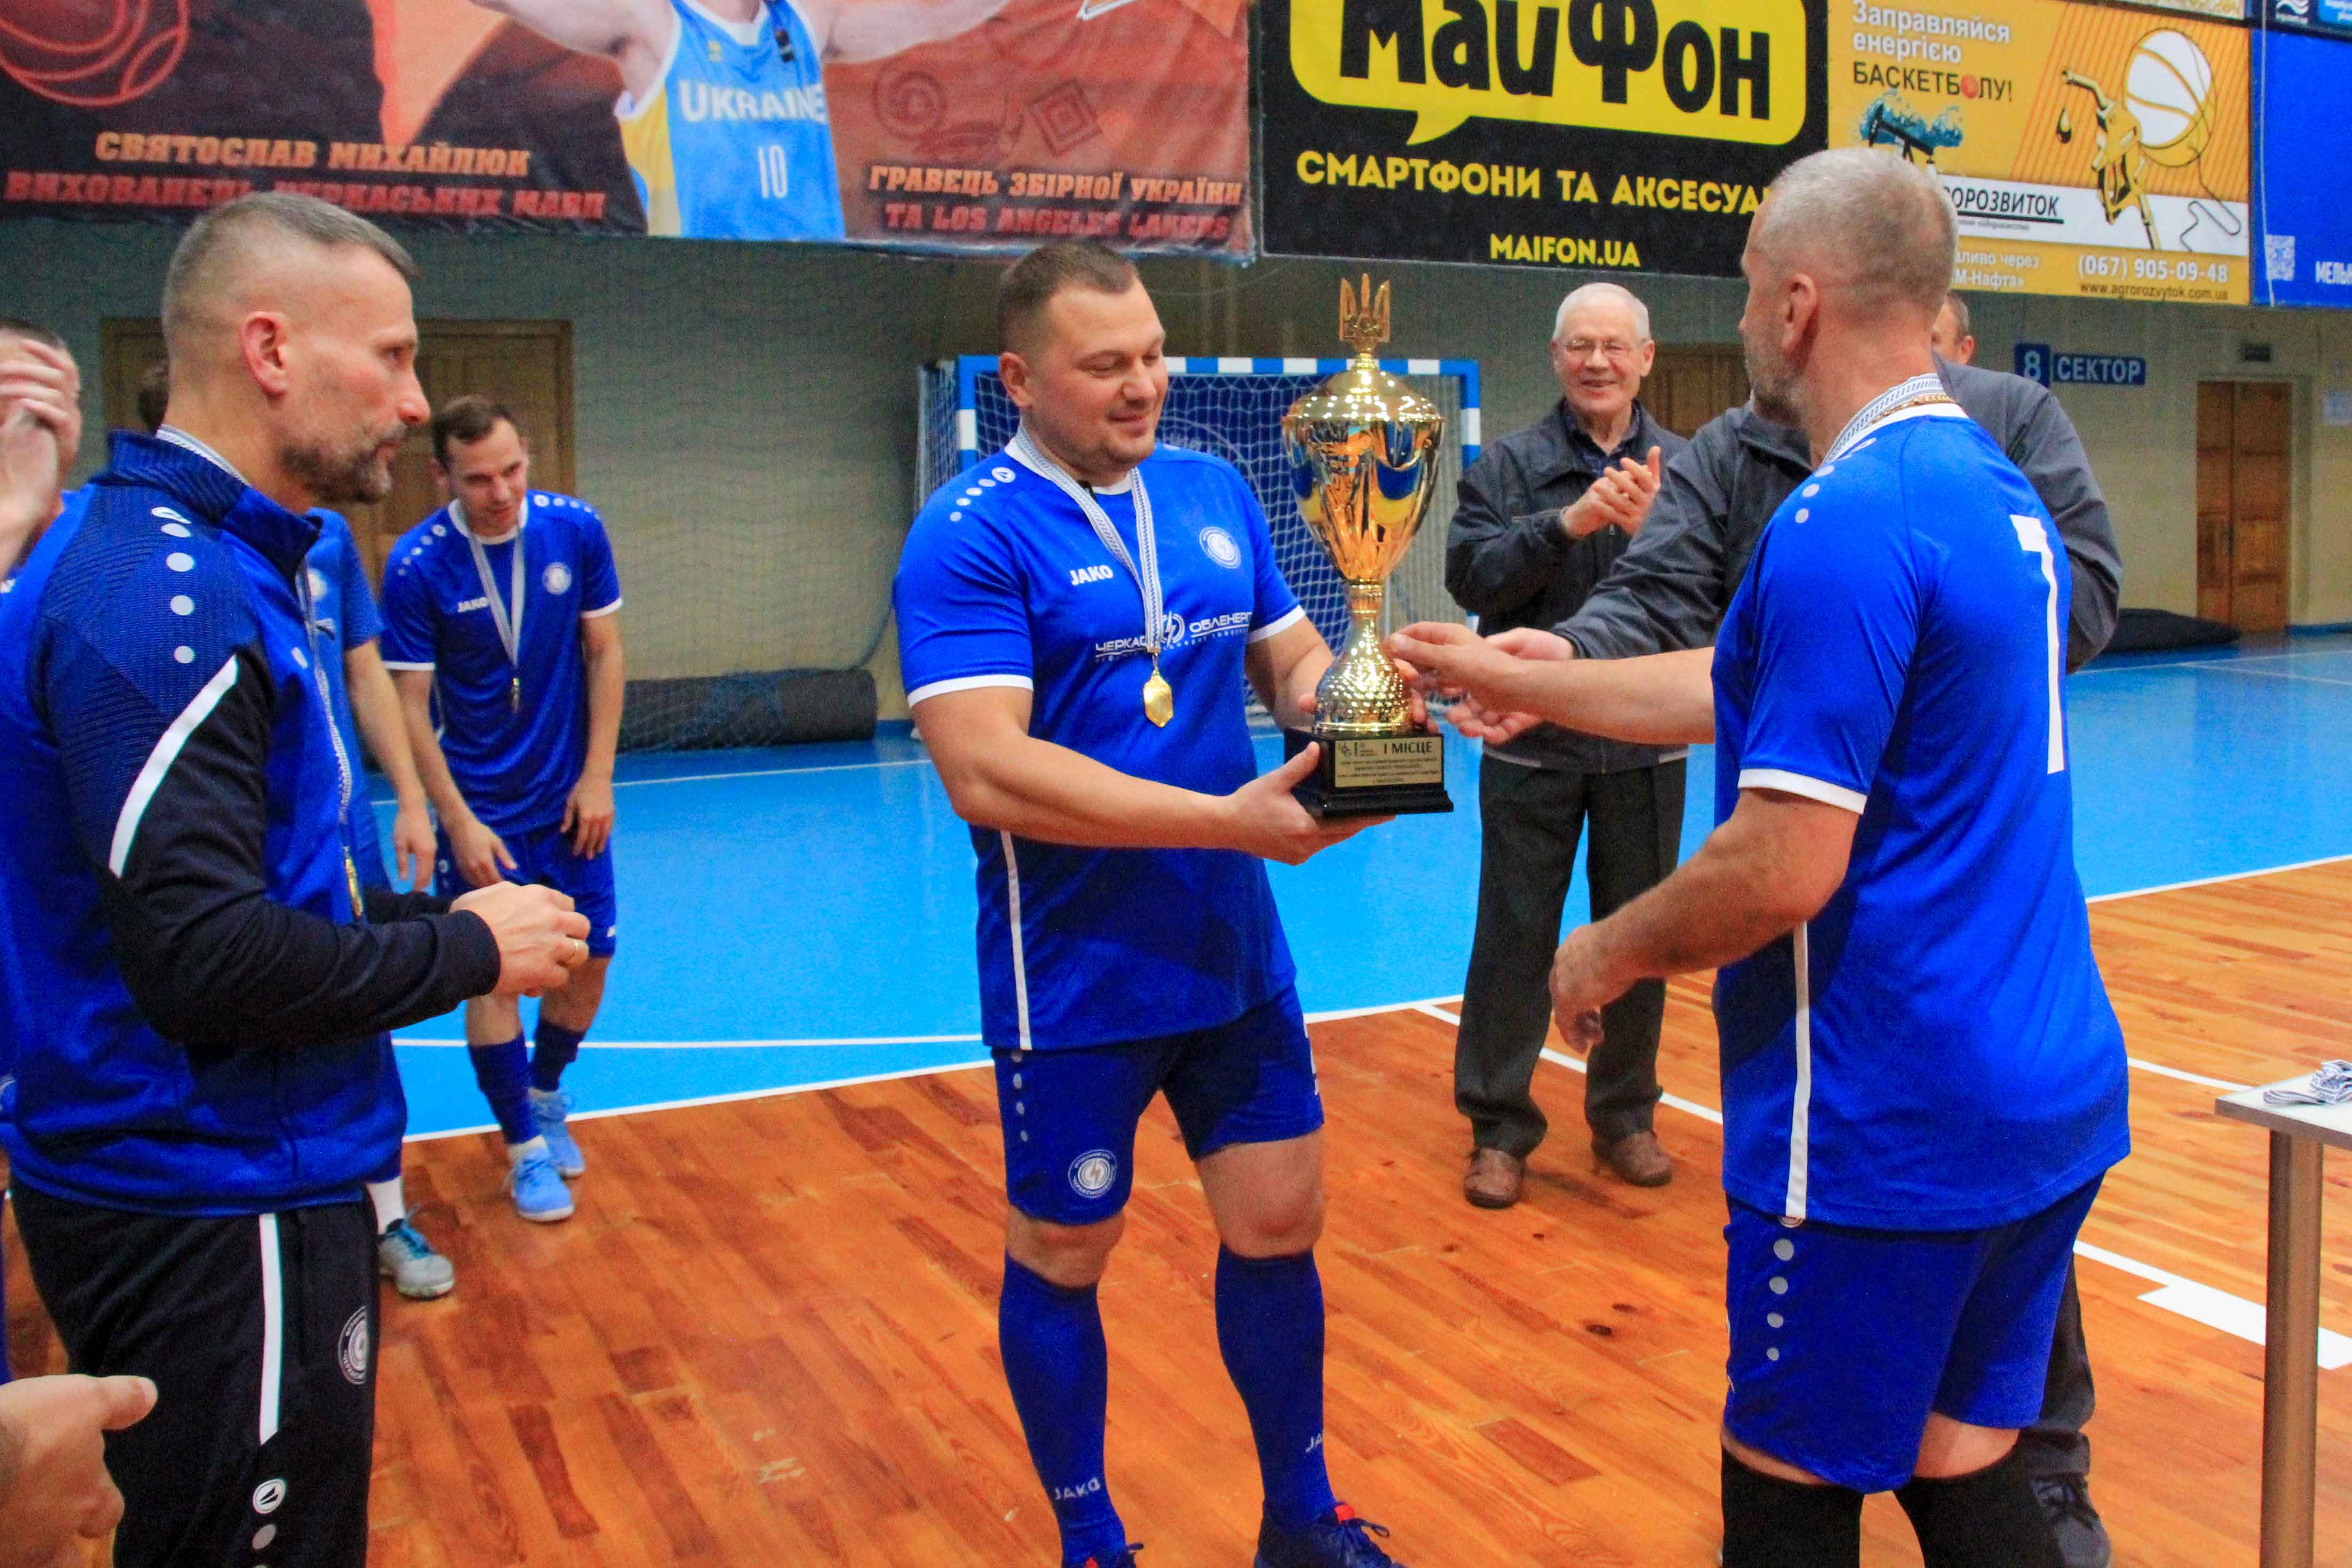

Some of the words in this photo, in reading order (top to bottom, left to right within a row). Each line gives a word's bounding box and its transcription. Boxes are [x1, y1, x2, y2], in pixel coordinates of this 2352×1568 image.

[1853, 0, 2011, 43] Заправляйся
[1853, 31, 1962, 63] енергією
[679, 80, 828, 123] UKRAINE
[95, 131, 318, 169] СВЯТОСЛАВ
[328, 141, 531, 177] МИХАЙЛЮК
[757, 145, 788, 199] 10
[869, 166, 999, 196] ГРАВЕЦЬ
[1009, 171, 1124, 201] ЗБІРНОЇ
[1130, 177, 1243, 205] УКРАЇНИ
[1296, 151, 1541, 199] СМАРТФОНИ
[1556, 169, 1599, 203] ТА
[1944, 186, 2059, 217] ОРОЗВИТОК
[885, 203, 922, 231] ТА
[932, 204, 988, 233] LOS
[996, 207, 1121, 235] ANGELES
[1490, 233, 1640, 267] MAIFON.UA
[1954, 251, 1996, 265] аливо
[2000, 255, 2039, 271] через
[1952, 268, 2025, 291] М-Нафта»
[2078, 255, 2127, 280] (067)
[2135, 258, 2228, 283] 905-09-48
[2315, 261, 2352, 286] МЕЛЬ
[2080, 282, 2228, 300] www.agrorozvytok.com.ua
[2024, 350, 2042, 382] 8
[2058, 356, 2141, 383] СЕКТОР
[1069, 565, 1114, 585] JAKO
[1392, 741, 1432, 756] МІСЦЕ
[1055, 1477, 1101, 1501] JAKO
